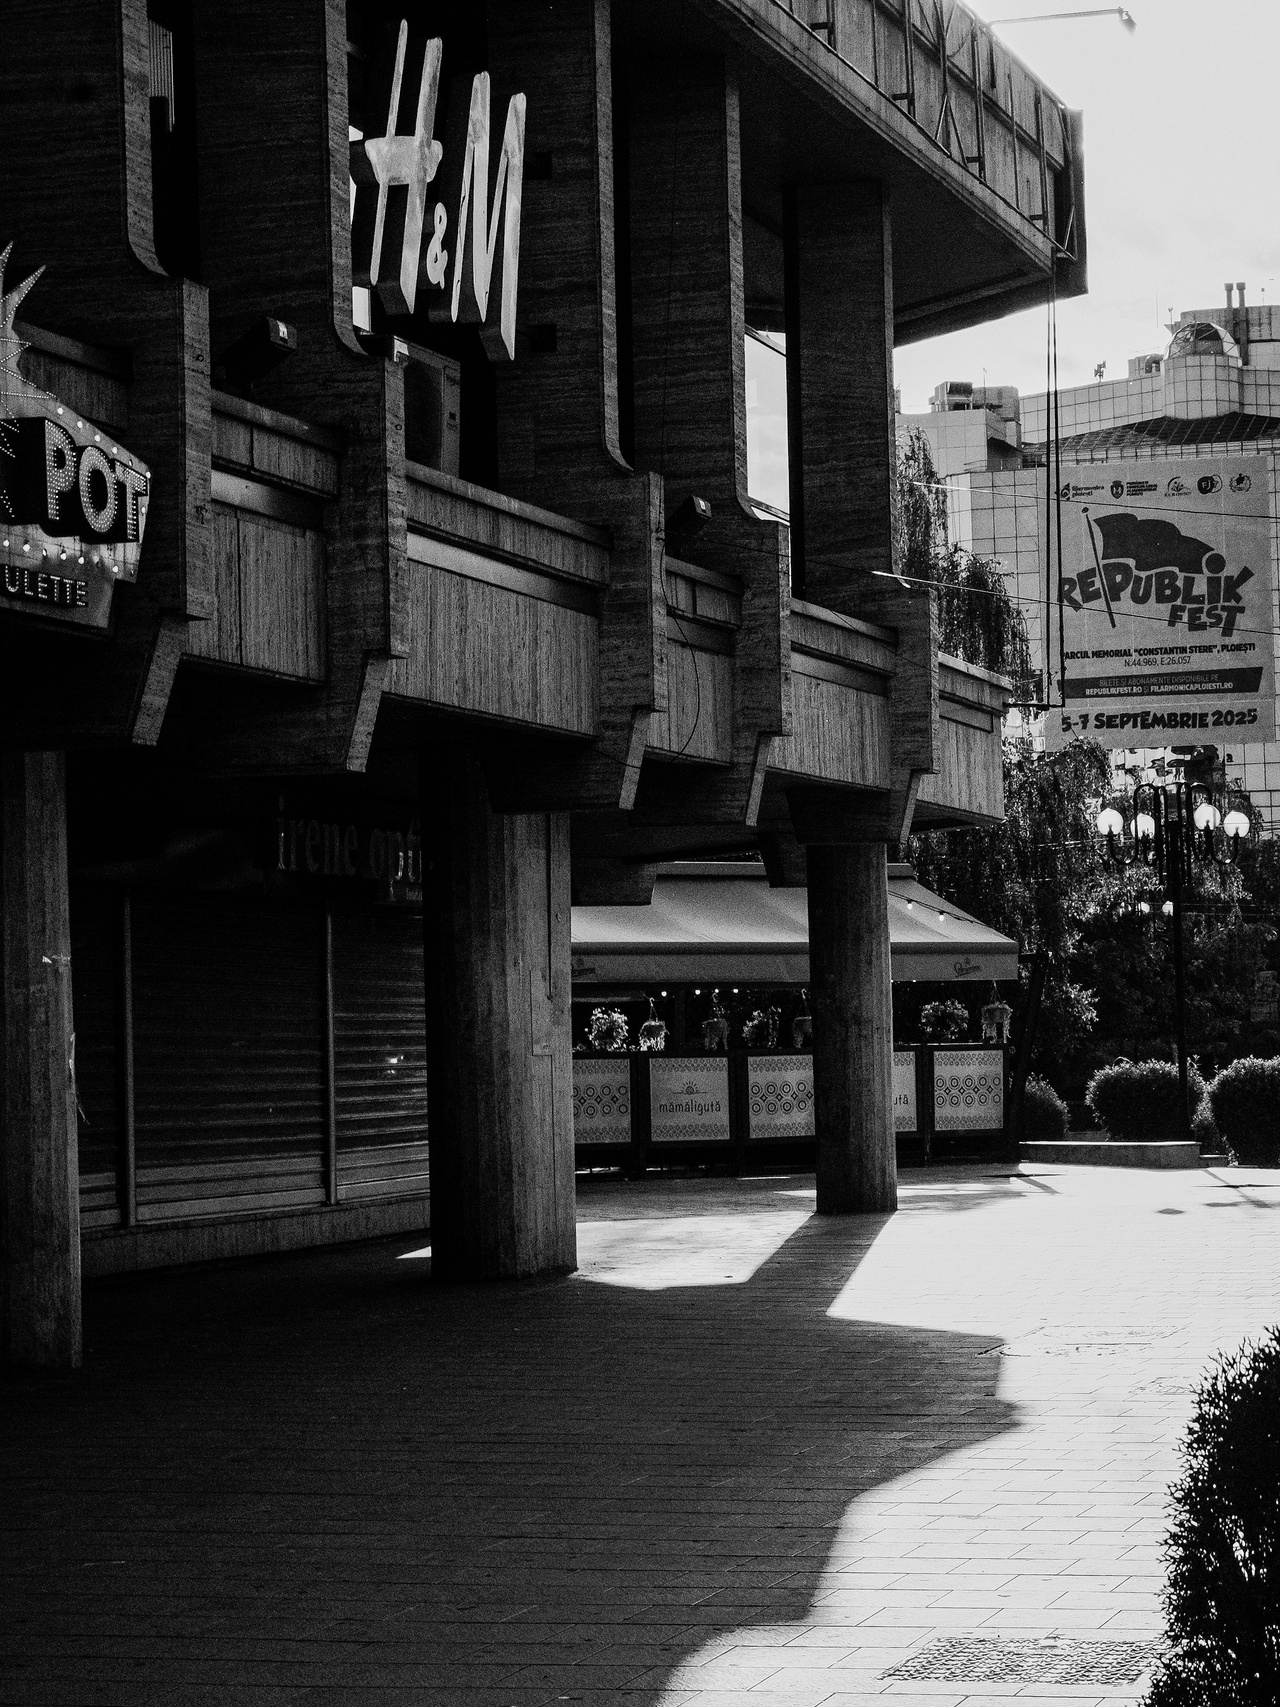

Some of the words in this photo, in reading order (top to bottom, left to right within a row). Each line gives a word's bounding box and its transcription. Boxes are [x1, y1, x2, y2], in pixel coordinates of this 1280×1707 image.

[365, 18, 527, 362] H&M
[44, 419, 149, 541] POT
[4, 564, 89, 607] ULETTE
[1057, 553, 1255, 612] REPUBLIK
[1168, 604, 1246, 638] FEST
[1062, 651, 1090, 660] ARCUL
[1091, 648, 1133, 659] MEMORIAL
[1128, 675, 1171, 686] ABONAMENTE
[1171, 674, 1210, 684] DISPONIBILE
[1210, 673, 1219, 681] PE
[1061, 713, 1090, 733] 5-7
[1094, 710, 1209, 730] SEPTEMBRIE
[1210, 708, 1258, 727] 2025
[276, 794, 359, 877] irene
